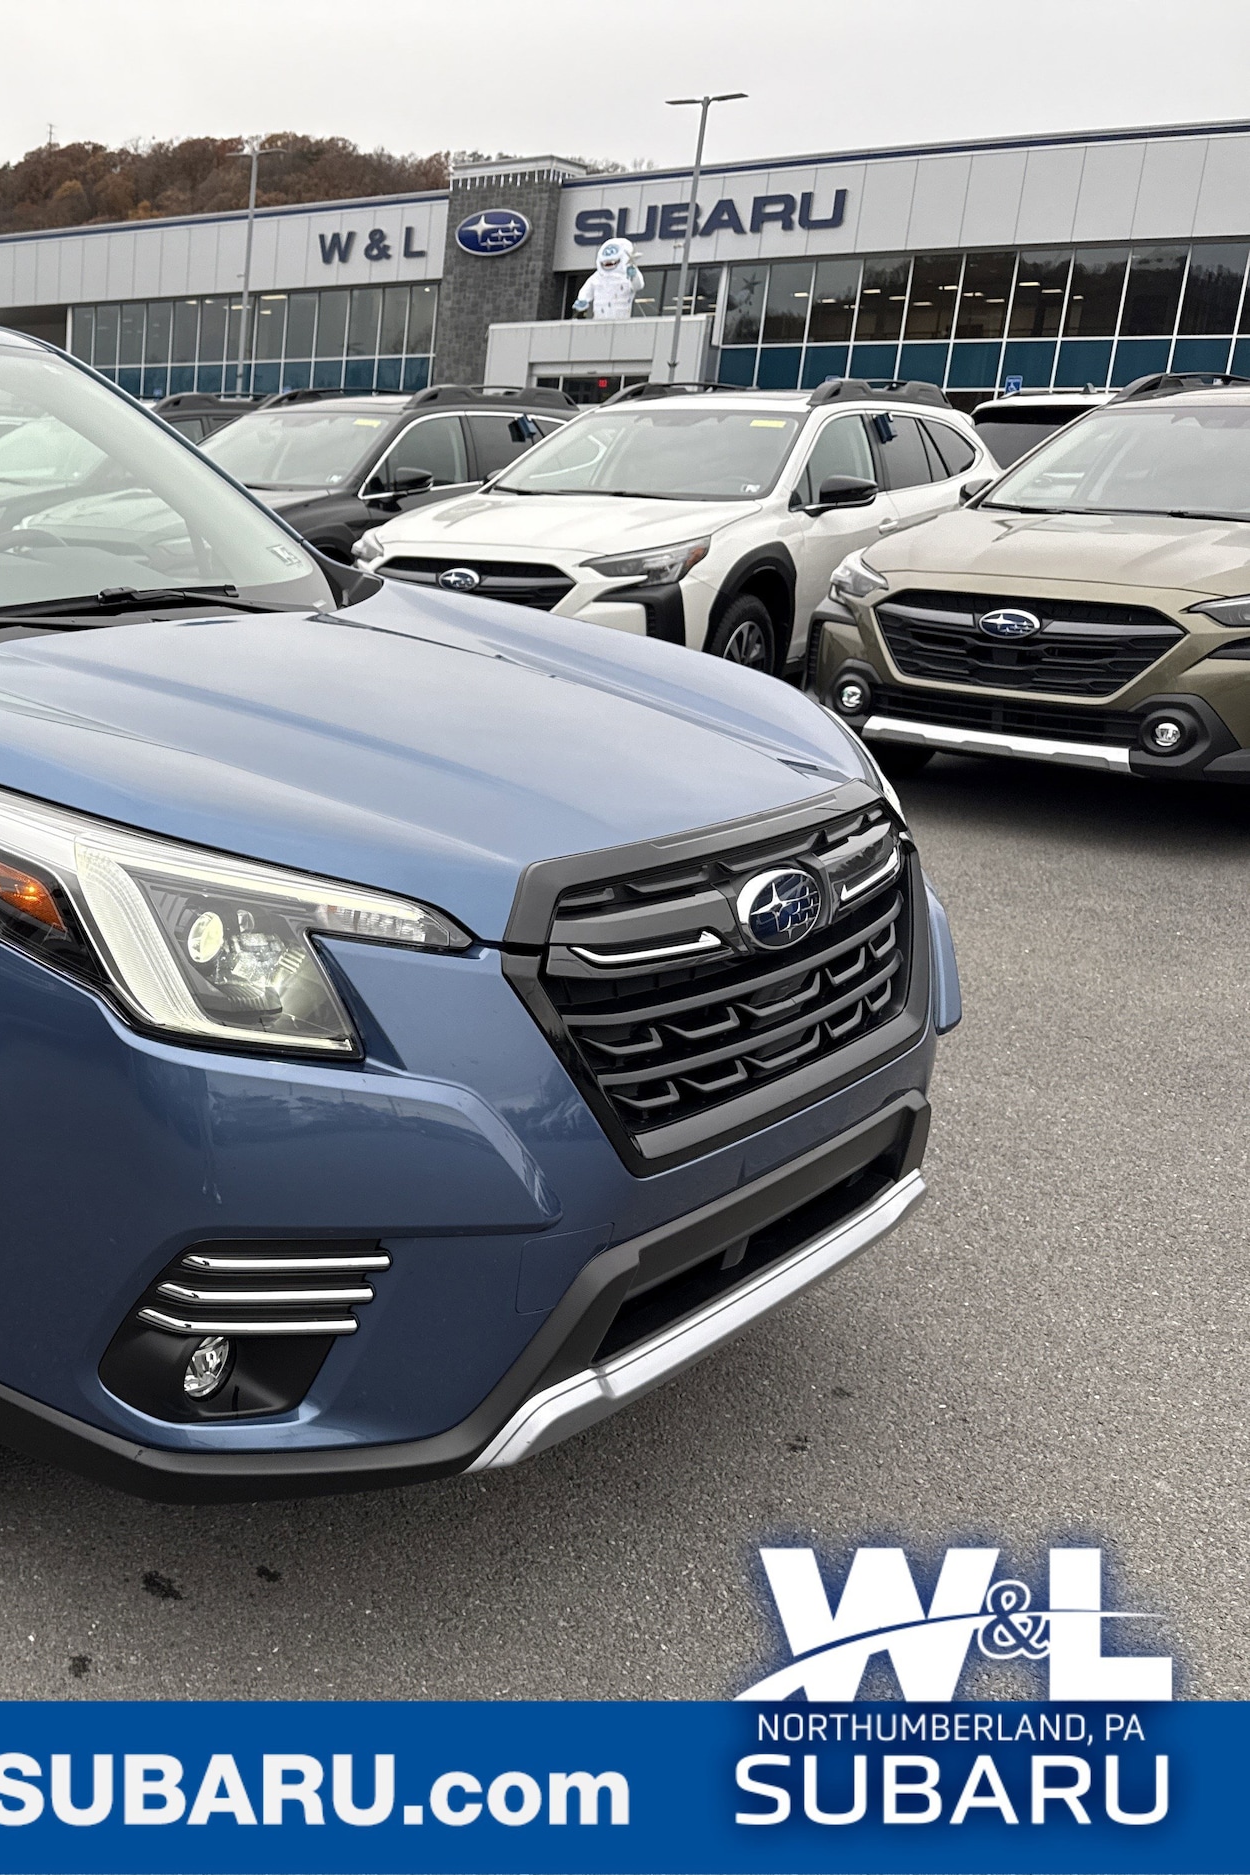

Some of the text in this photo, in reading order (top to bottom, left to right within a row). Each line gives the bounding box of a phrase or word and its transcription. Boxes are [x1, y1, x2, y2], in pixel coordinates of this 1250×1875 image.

[574, 189, 848, 246] SUBARU
[319, 226, 427, 265] W & L
